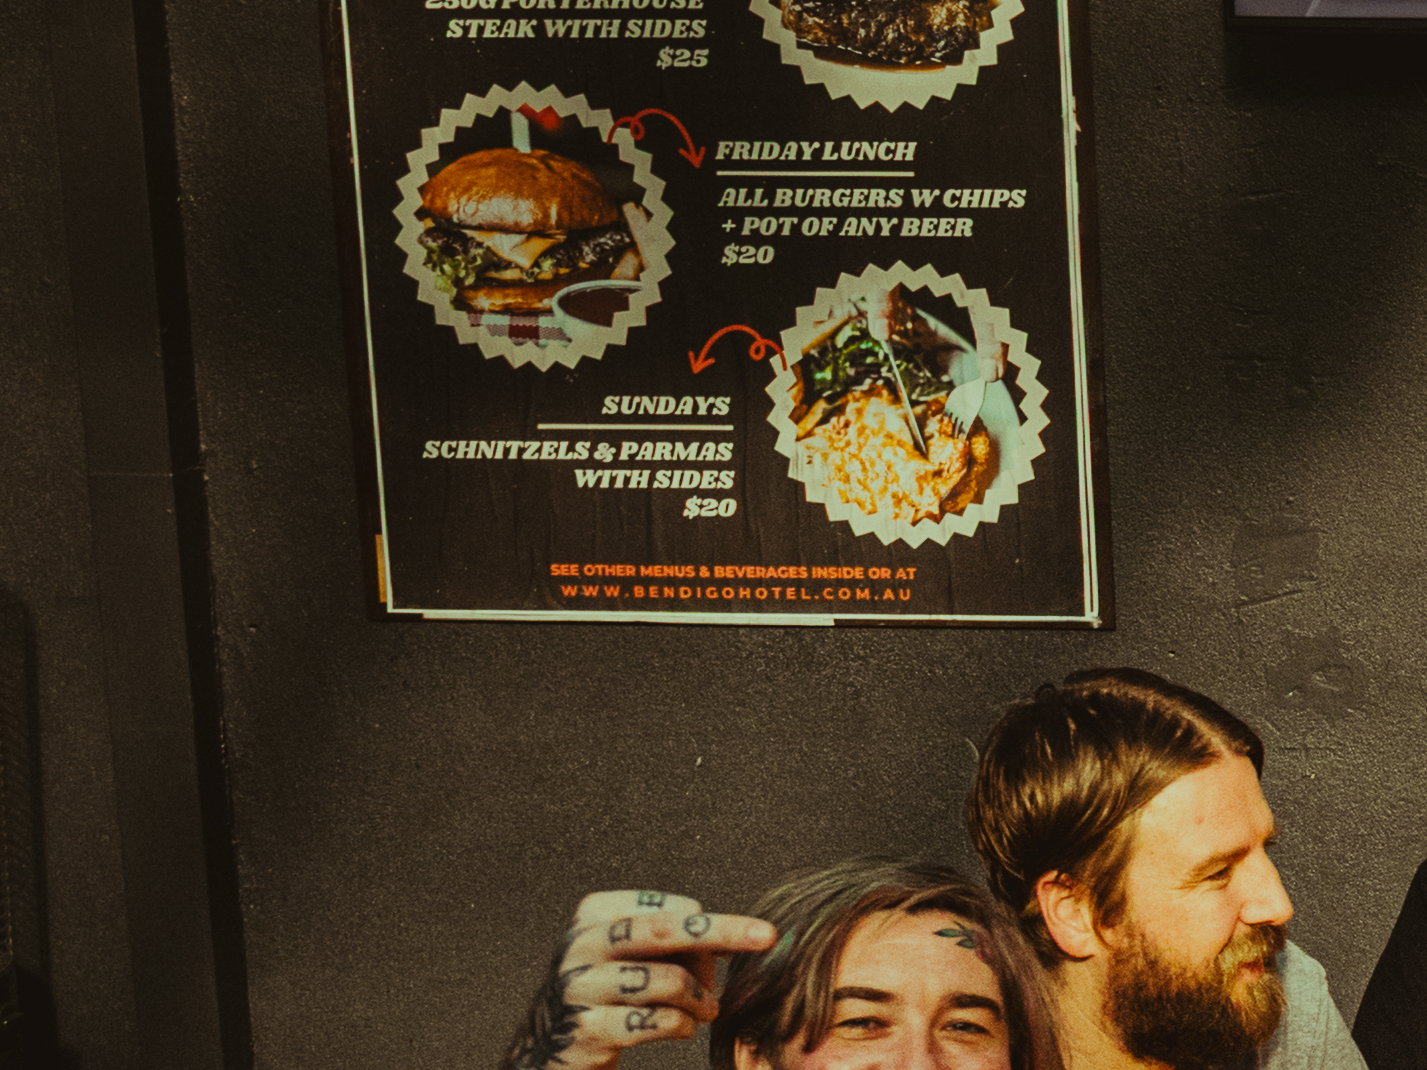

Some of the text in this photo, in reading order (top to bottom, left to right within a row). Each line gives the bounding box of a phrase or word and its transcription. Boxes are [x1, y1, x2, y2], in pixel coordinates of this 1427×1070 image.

[446, 19, 707, 38] STEAK WITH SIDES
[657, 46, 709, 70] $25
[715, 142, 917, 161] FRIDAY LUNCH
[718, 188, 1026, 208] ALL BURGERS W CHIPS
[741, 217, 798, 235] POT
[802, 217, 837, 236] OF
[839, 217, 898, 236] ANY
[900, 218, 973, 237] BEER
[722, 243, 774, 266] $20
[602, 396, 730, 415] SUNDAYS
[423, 441, 733, 462] SCHNITZELS & PARMAS
[574, 469, 735, 489] WITH SIDES
[683, 496, 737, 519] $20
[550, 564, 916, 579] SEE OTHER MENUS & BEVERAGES INSIDE OR AT
[561, 585, 910, 601] WWW.BENDIGOHOTEL.COM.AU
